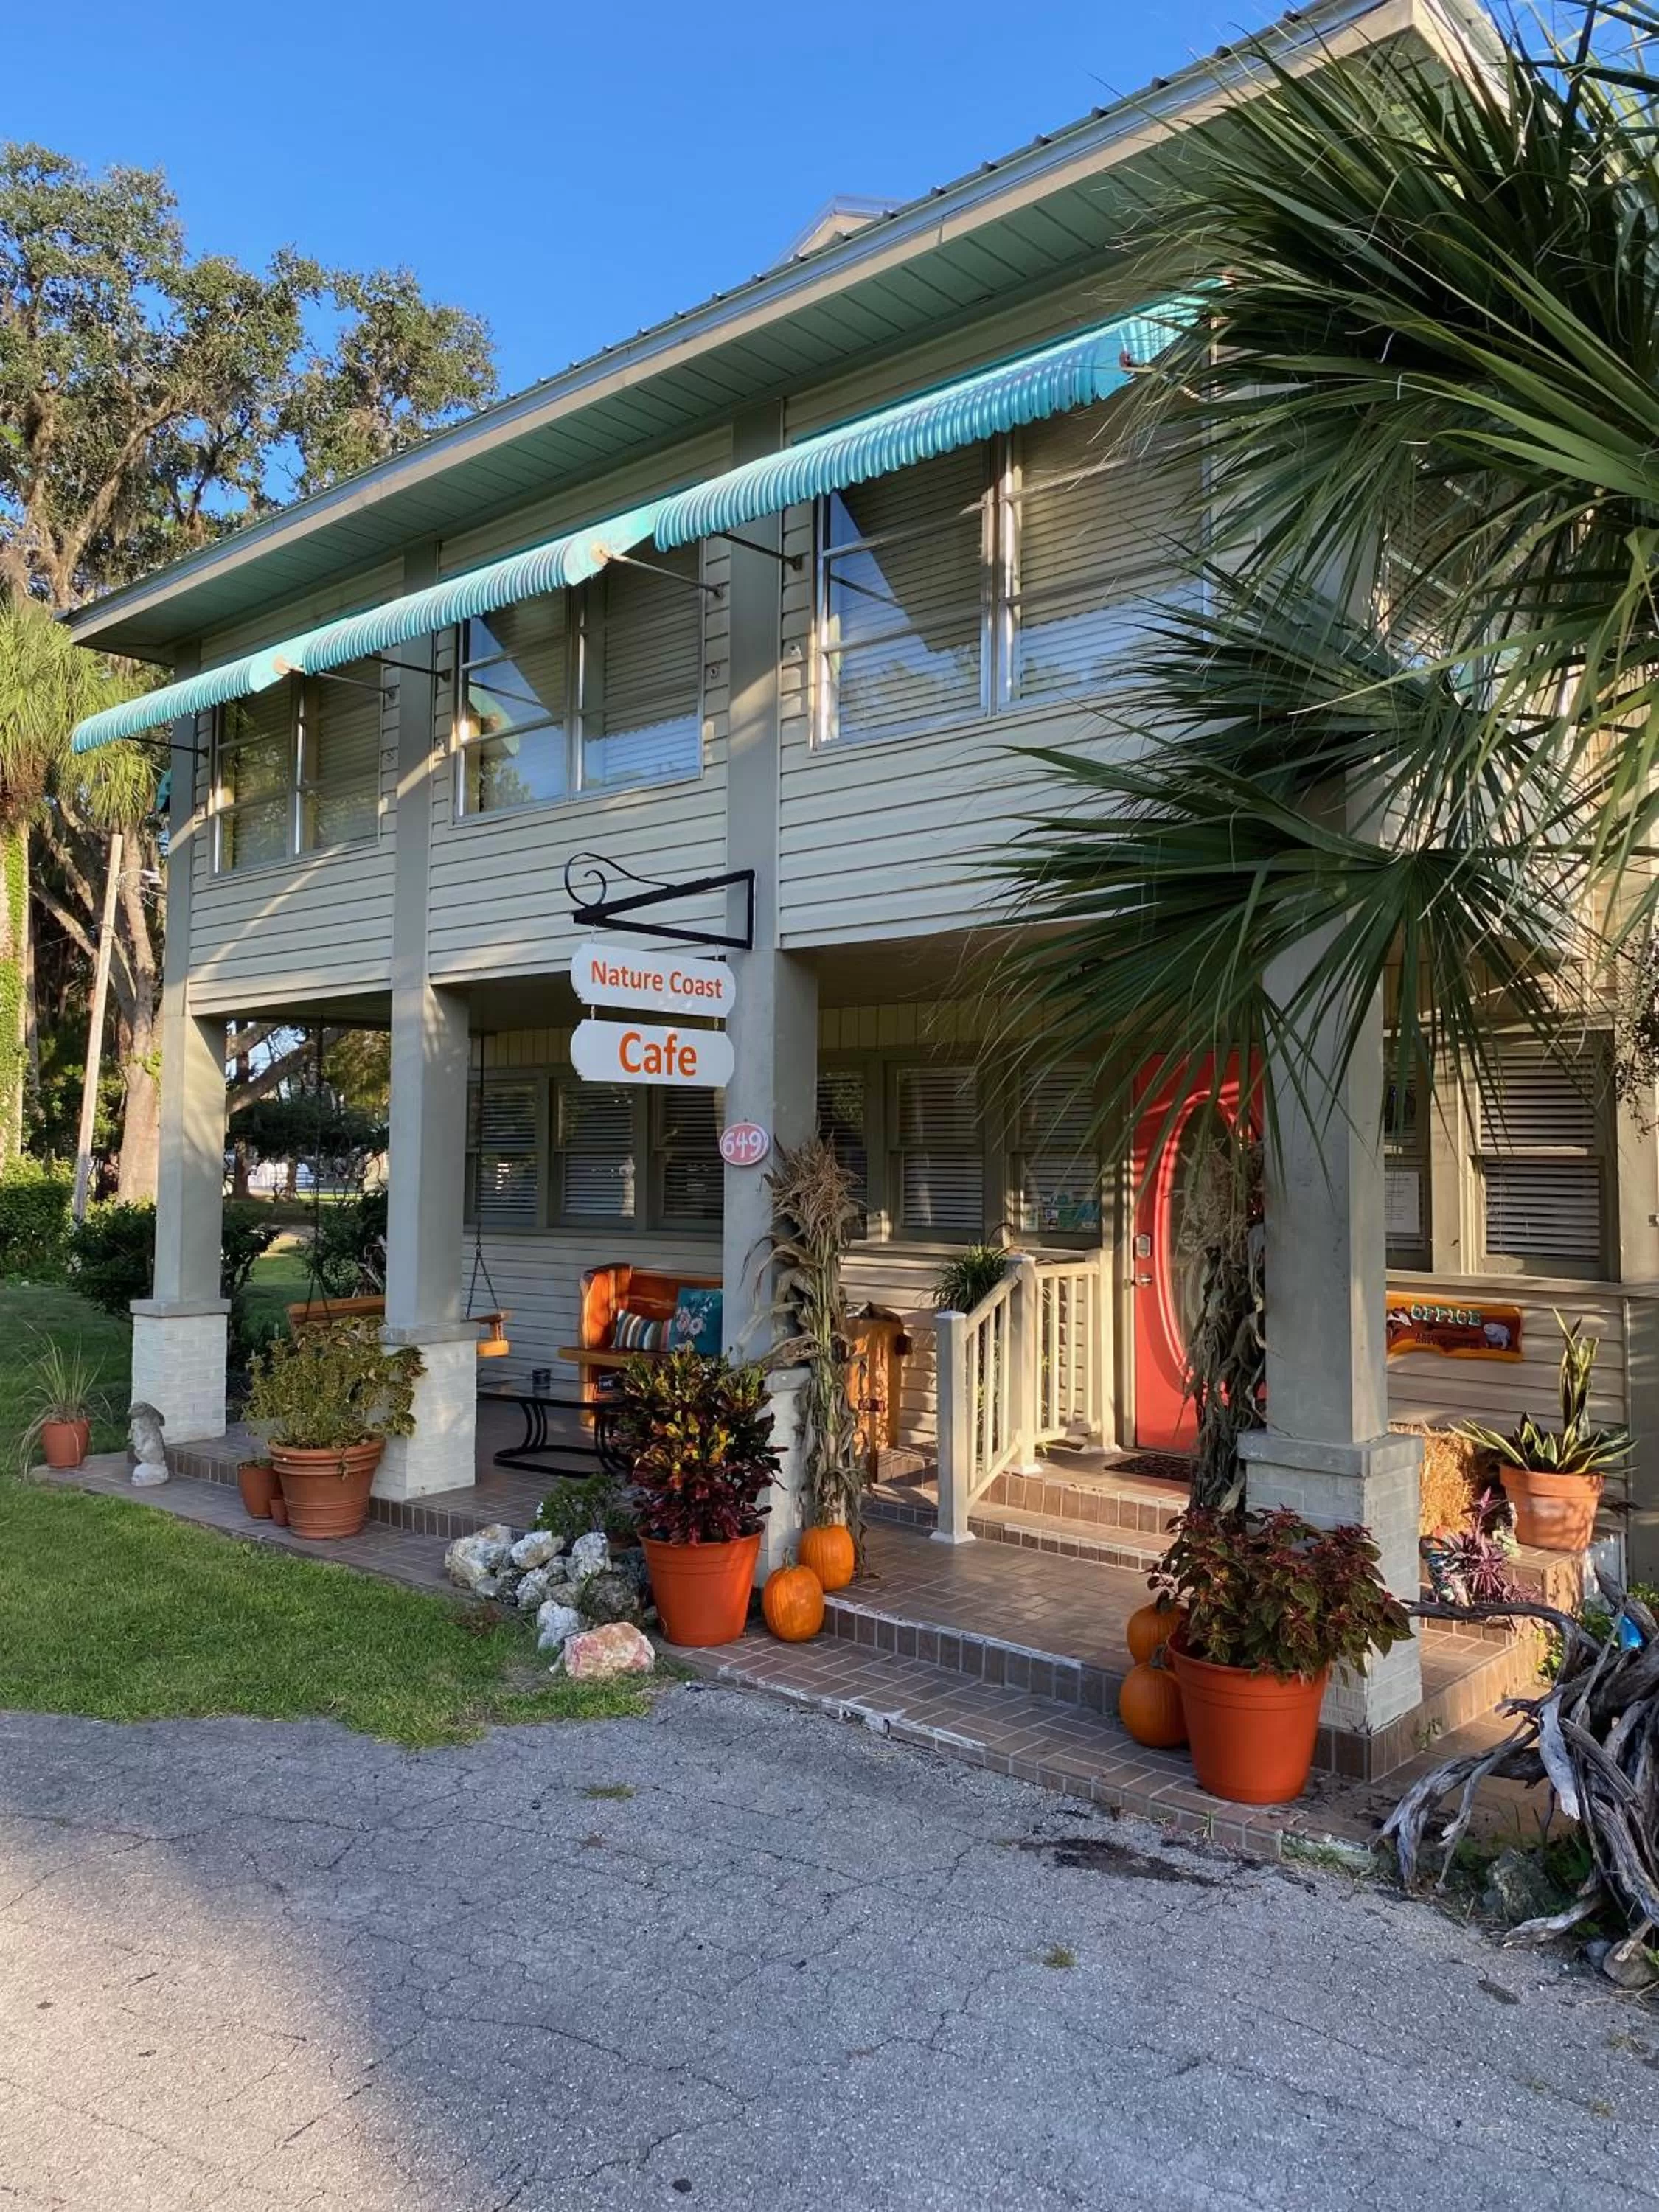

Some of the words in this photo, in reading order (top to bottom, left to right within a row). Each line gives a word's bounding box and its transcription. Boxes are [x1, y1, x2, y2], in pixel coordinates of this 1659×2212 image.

[591, 961, 663, 992] Nature
[669, 970, 723, 999] Coast
[619, 1032, 698, 1077] Cafe
[723, 1131, 762, 1158] 649
[1411, 1304, 1482, 1326] OFFICE
